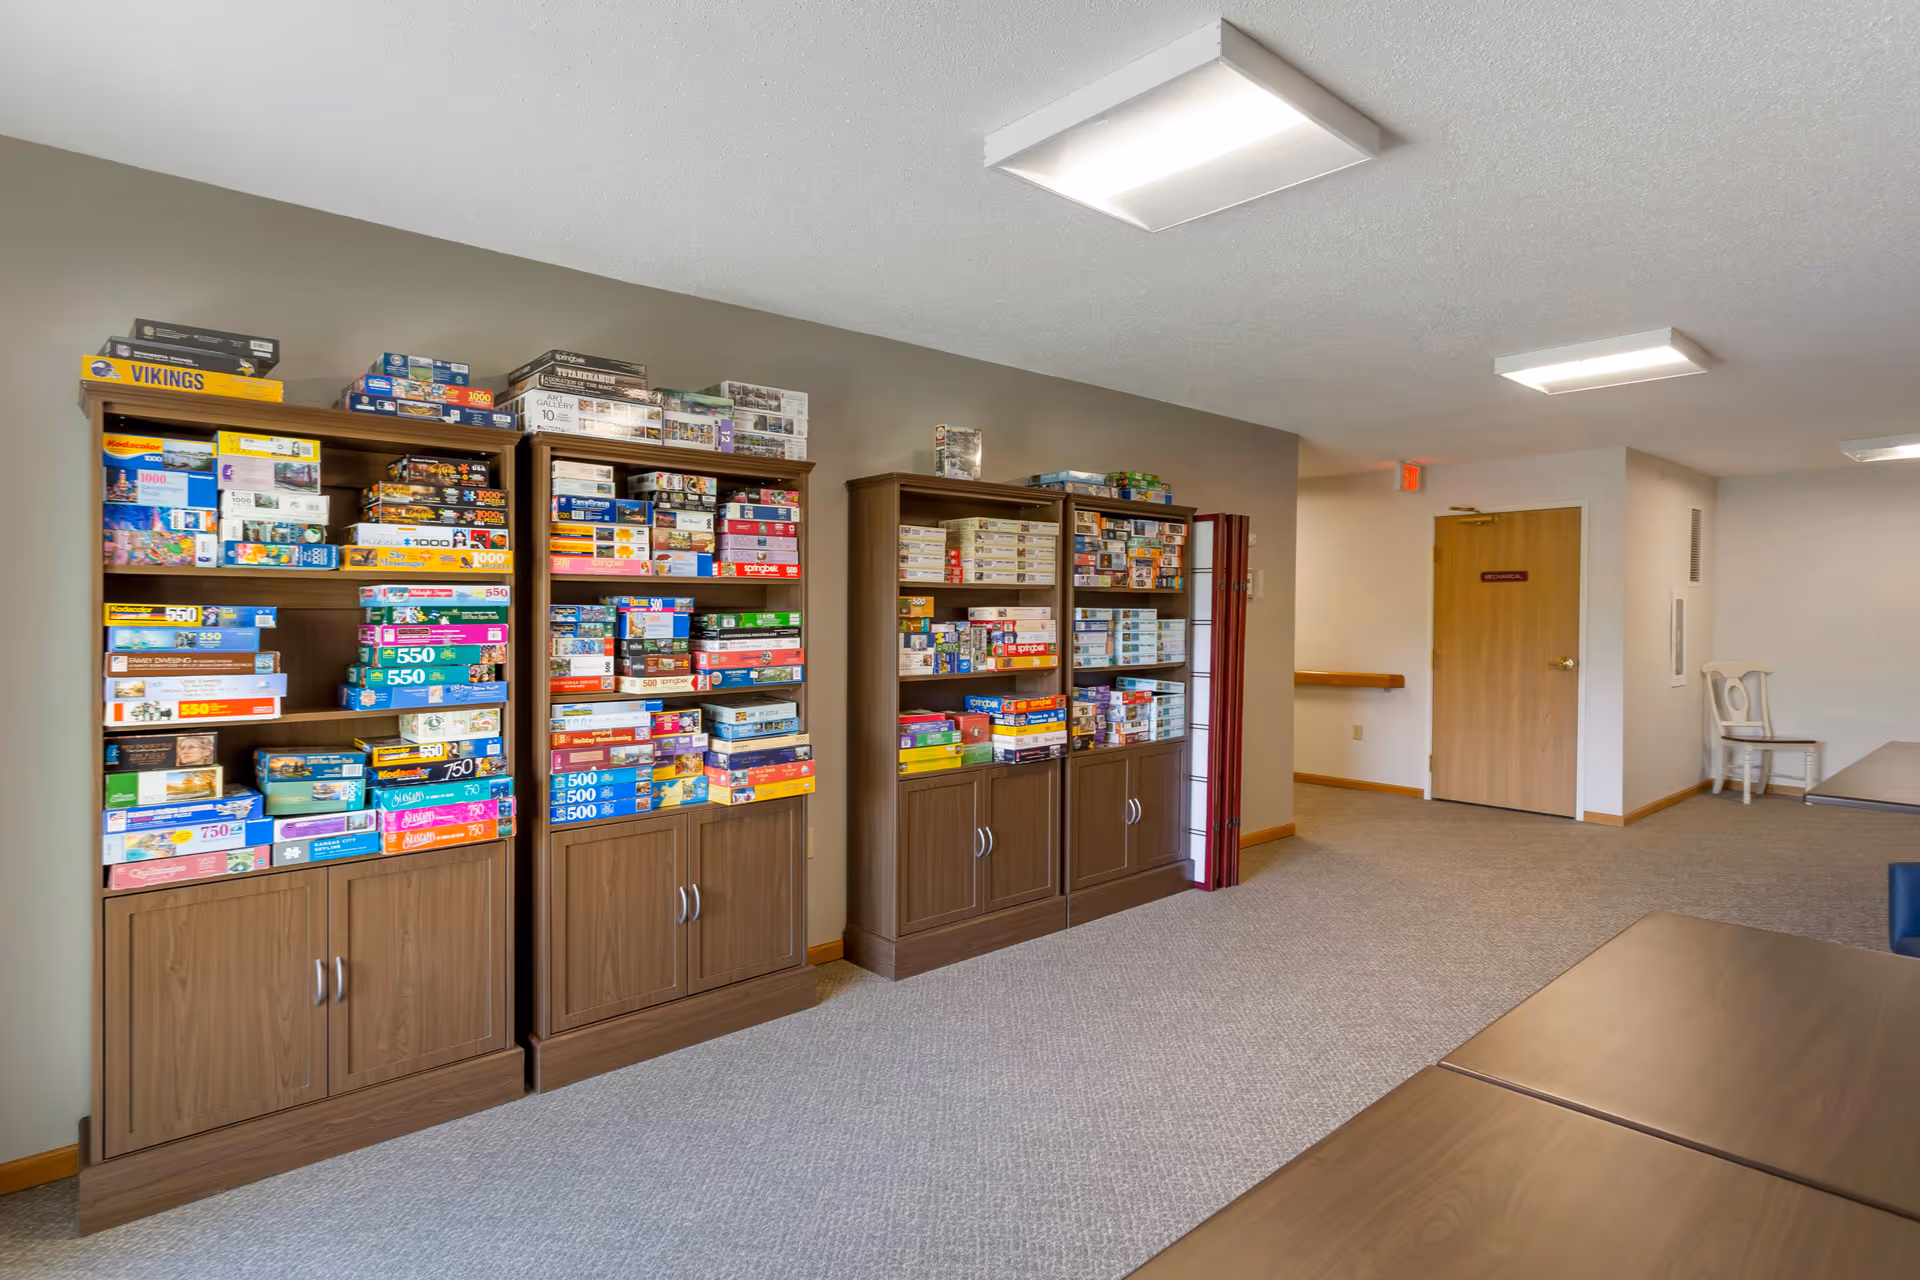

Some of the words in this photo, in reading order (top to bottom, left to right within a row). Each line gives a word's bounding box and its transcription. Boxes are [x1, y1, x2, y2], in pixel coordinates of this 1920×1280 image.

[131, 364, 205, 391] VIKINGS
[544, 376, 577, 386] ADORATION
[556, 367, 616, 385] TUTANKHAMUN
[468, 391, 491, 402] 1000
[547, 394, 563, 402] ART
[536, 399, 574, 410] GALLERY
[542, 410, 554, 421] 10
[721, 430, 730, 443] 12
[106, 440, 162, 451] Kodacolor
[472, 464, 486, 472] USA
[140, 473, 166, 484] 1000
[1403, 464, 1420, 491] EXIT
[476, 490, 500, 502] 1000
[476, 510, 500, 521] 1000
[412, 538, 450, 547] 1000
[389, 550, 406, 561] Sky
[471, 552, 505, 568] 1000
[380, 558, 426, 569] Messenger
[744, 564, 778, 574] springbok
[786, 566, 798, 574] 500
[486, 588, 508, 598] 550
[650, 598, 662, 612] 500
[164, 607, 197, 622] 550
[200, 632, 222, 640] 550
[1018, 644, 1046, 654] springbok
[154, 656, 192, 664] DWELLING
[396, 647, 435, 664] 550
[387, 669, 426, 685] 550
[642, 679, 657, 687] 500
[180, 703, 209, 716] 550
[970, 698, 999, 710] springbok
[420, 744, 444, 758] 550
[378, 766, 432, 780] Kodacolor
[444, 758, 474, 781] 750
[568, 772, 598, 787] 500
[464, 784, 480, 796] 750
[566, 788, 596, 803] 500
[468, 804, 484, 816] 750
[566, 804, 597, 820] 500
[200, 824, 229, 839] 750
[468, 824, 484, 836] 750
